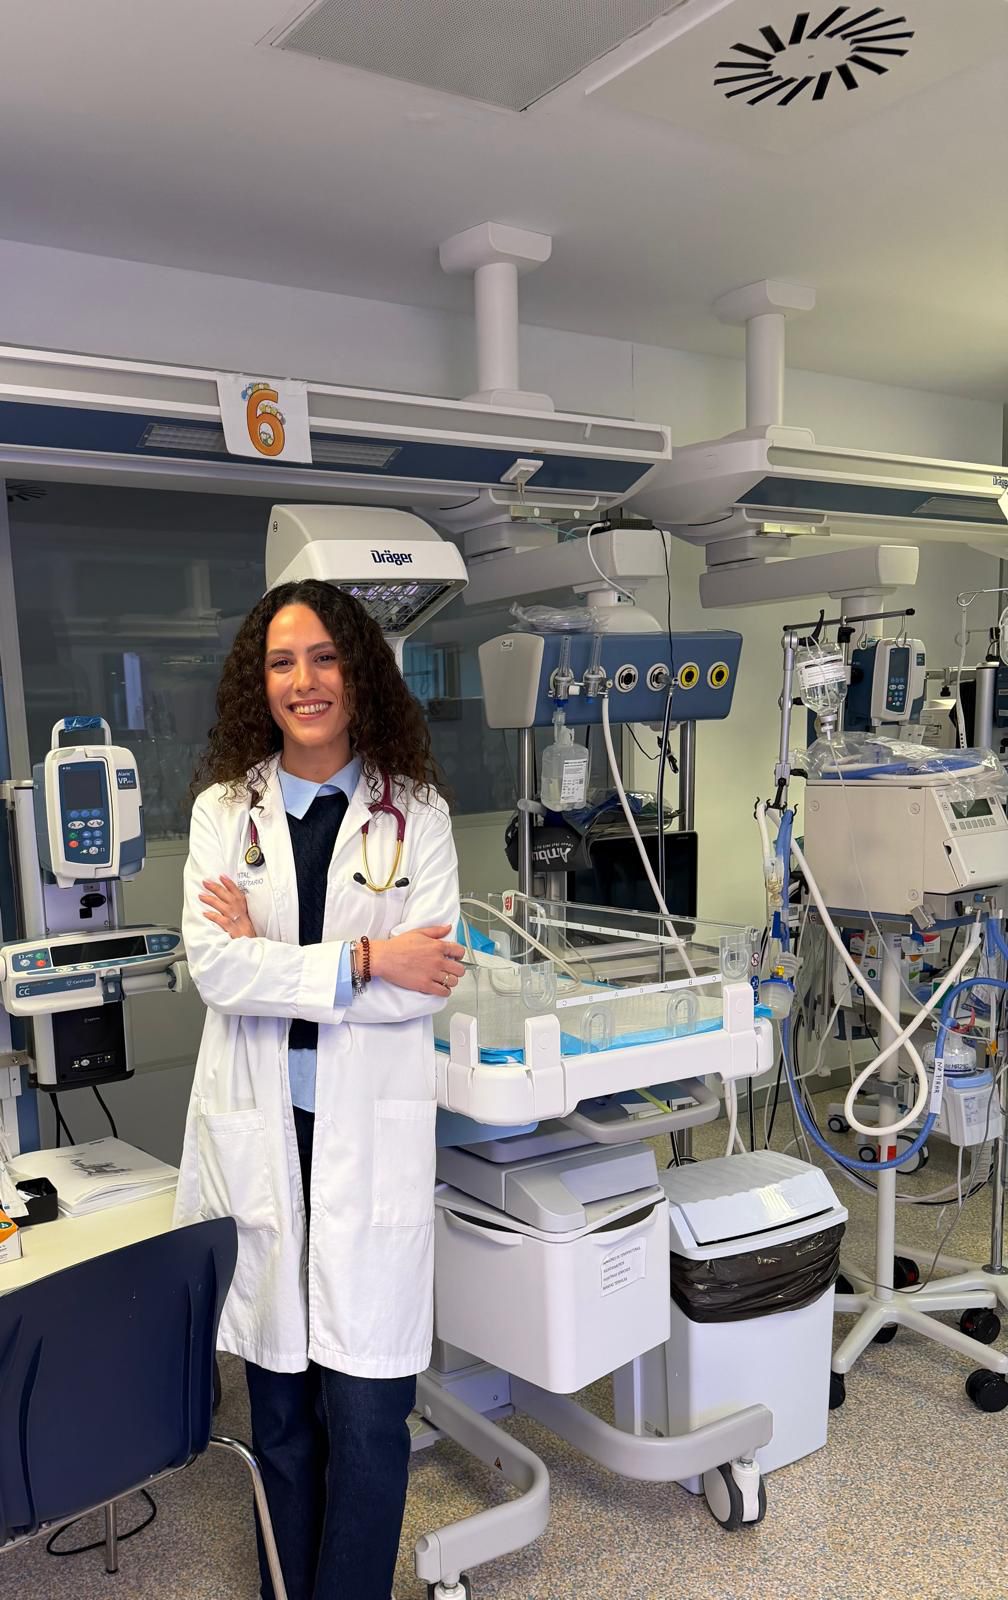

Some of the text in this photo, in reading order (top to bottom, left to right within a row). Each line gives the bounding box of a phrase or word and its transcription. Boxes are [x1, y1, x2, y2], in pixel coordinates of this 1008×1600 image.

[247, 389, 285, 456] 6
[370, 550, 413, 566] Dräger
[18, 988, 30, 996] CC
